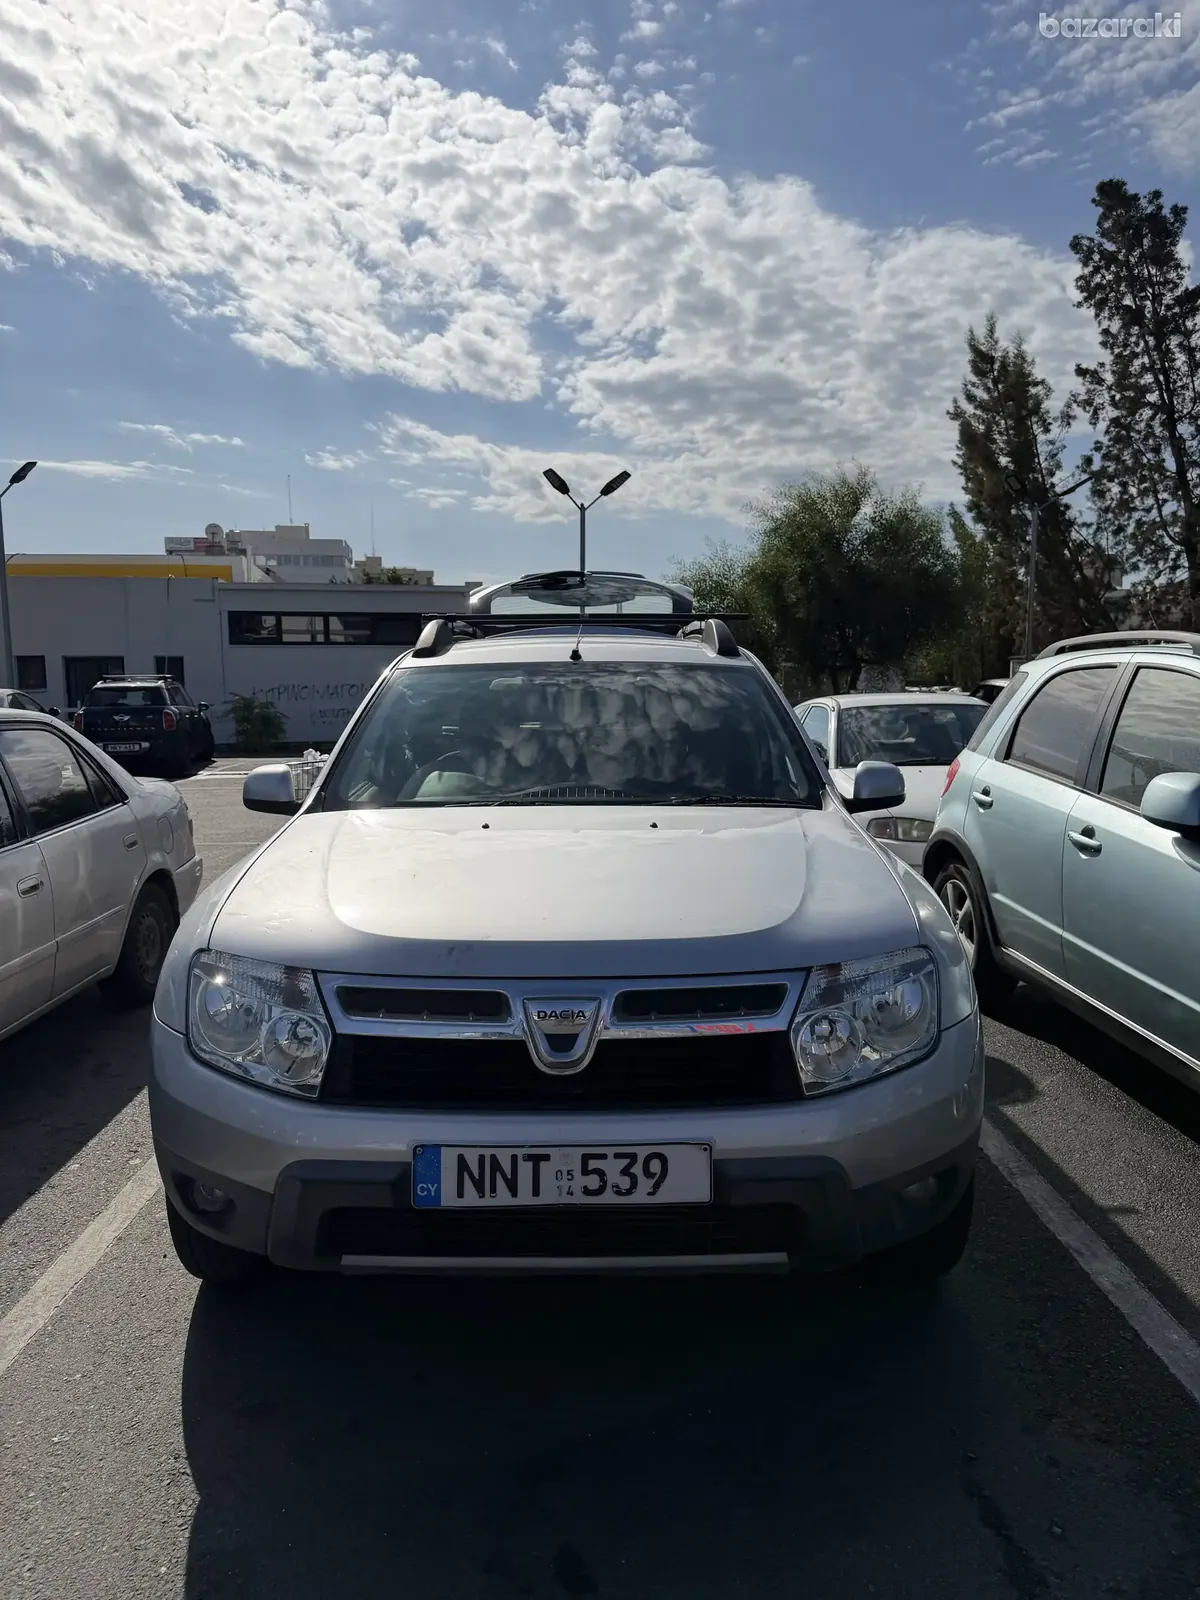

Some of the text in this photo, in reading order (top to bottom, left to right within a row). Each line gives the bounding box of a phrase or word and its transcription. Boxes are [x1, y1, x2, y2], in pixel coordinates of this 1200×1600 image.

[537, 1010, 587, 1020] DACIA
[456, 1152, 669, 1199] NNT 539
[555, 1169, 575, 1182] 05
[416, 1183, 438, 1197] CY
